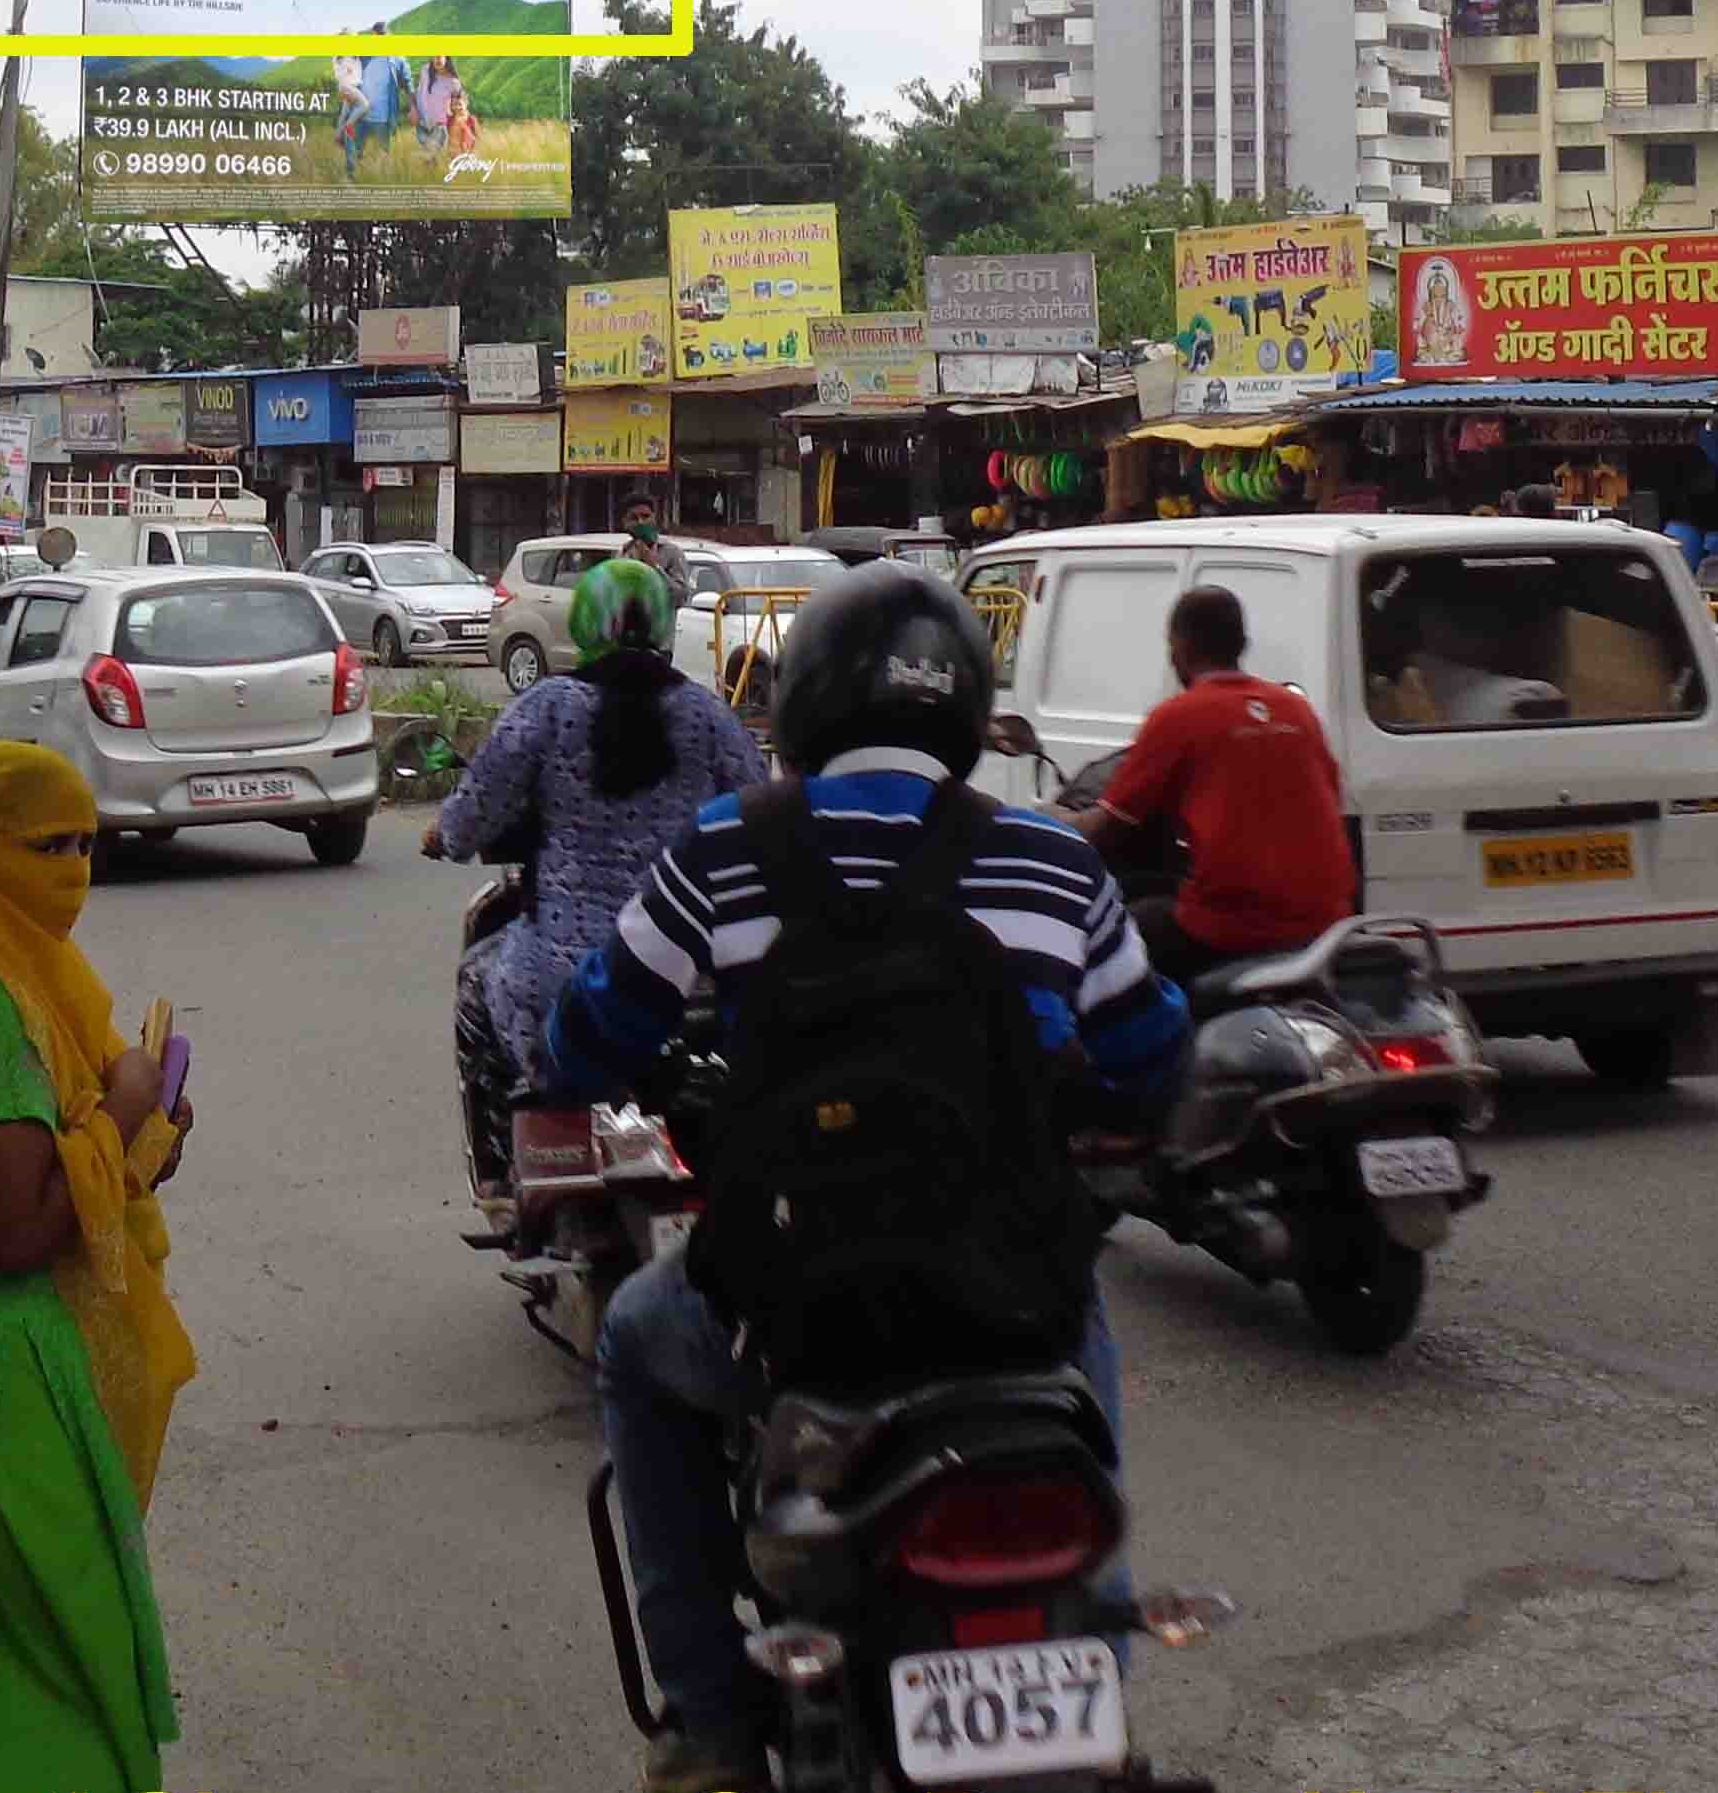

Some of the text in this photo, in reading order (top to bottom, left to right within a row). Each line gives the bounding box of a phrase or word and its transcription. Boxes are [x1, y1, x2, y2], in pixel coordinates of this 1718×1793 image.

[95, 86, 330, 112] 1, 2 & 3 BHK STARTING AT
[93, 117, 306, 144] ₹39.9 LAKH (ALL INCL.)
[126, 153, 292, 175] 98990 06466
[1476, 266, 1571, 310] उत्तम
[1563, 315, 1633, 363] गादी
[1641, 313, 1708, 361] सेंटर
[911, 1677, 1103, 1751] 4057
